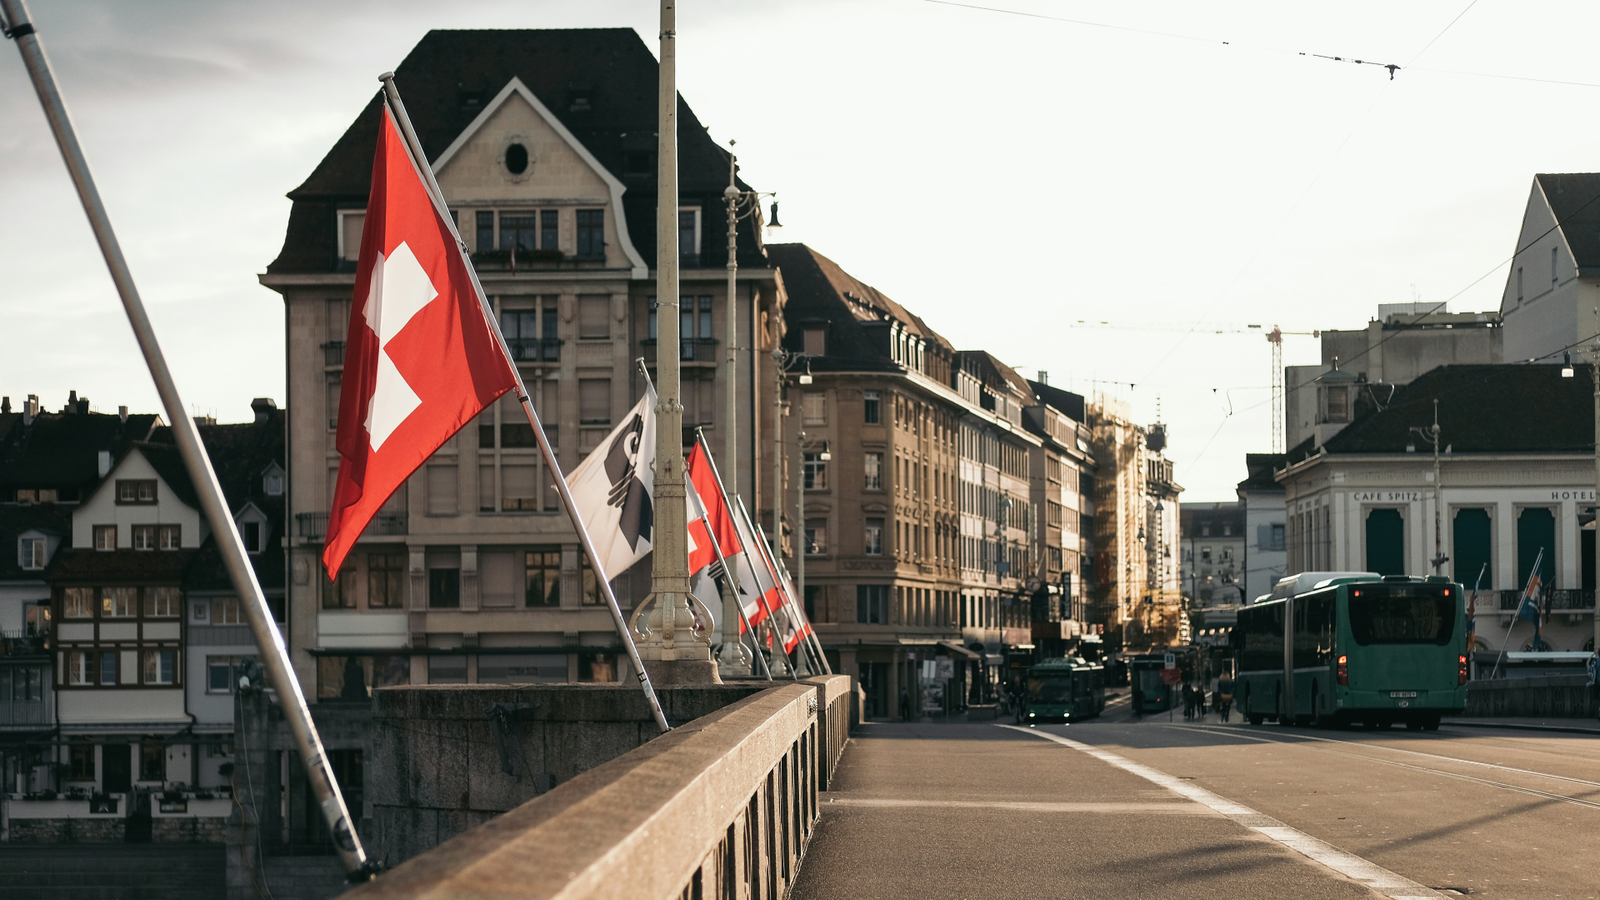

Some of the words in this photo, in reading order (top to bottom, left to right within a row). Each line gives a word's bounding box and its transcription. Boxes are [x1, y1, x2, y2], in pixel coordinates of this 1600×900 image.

[1353, 492, 1382, 501] CAFE
[1388, 492, 1418, 501] SPITZ
[1551, 491, 1595, 500] HOTEL
